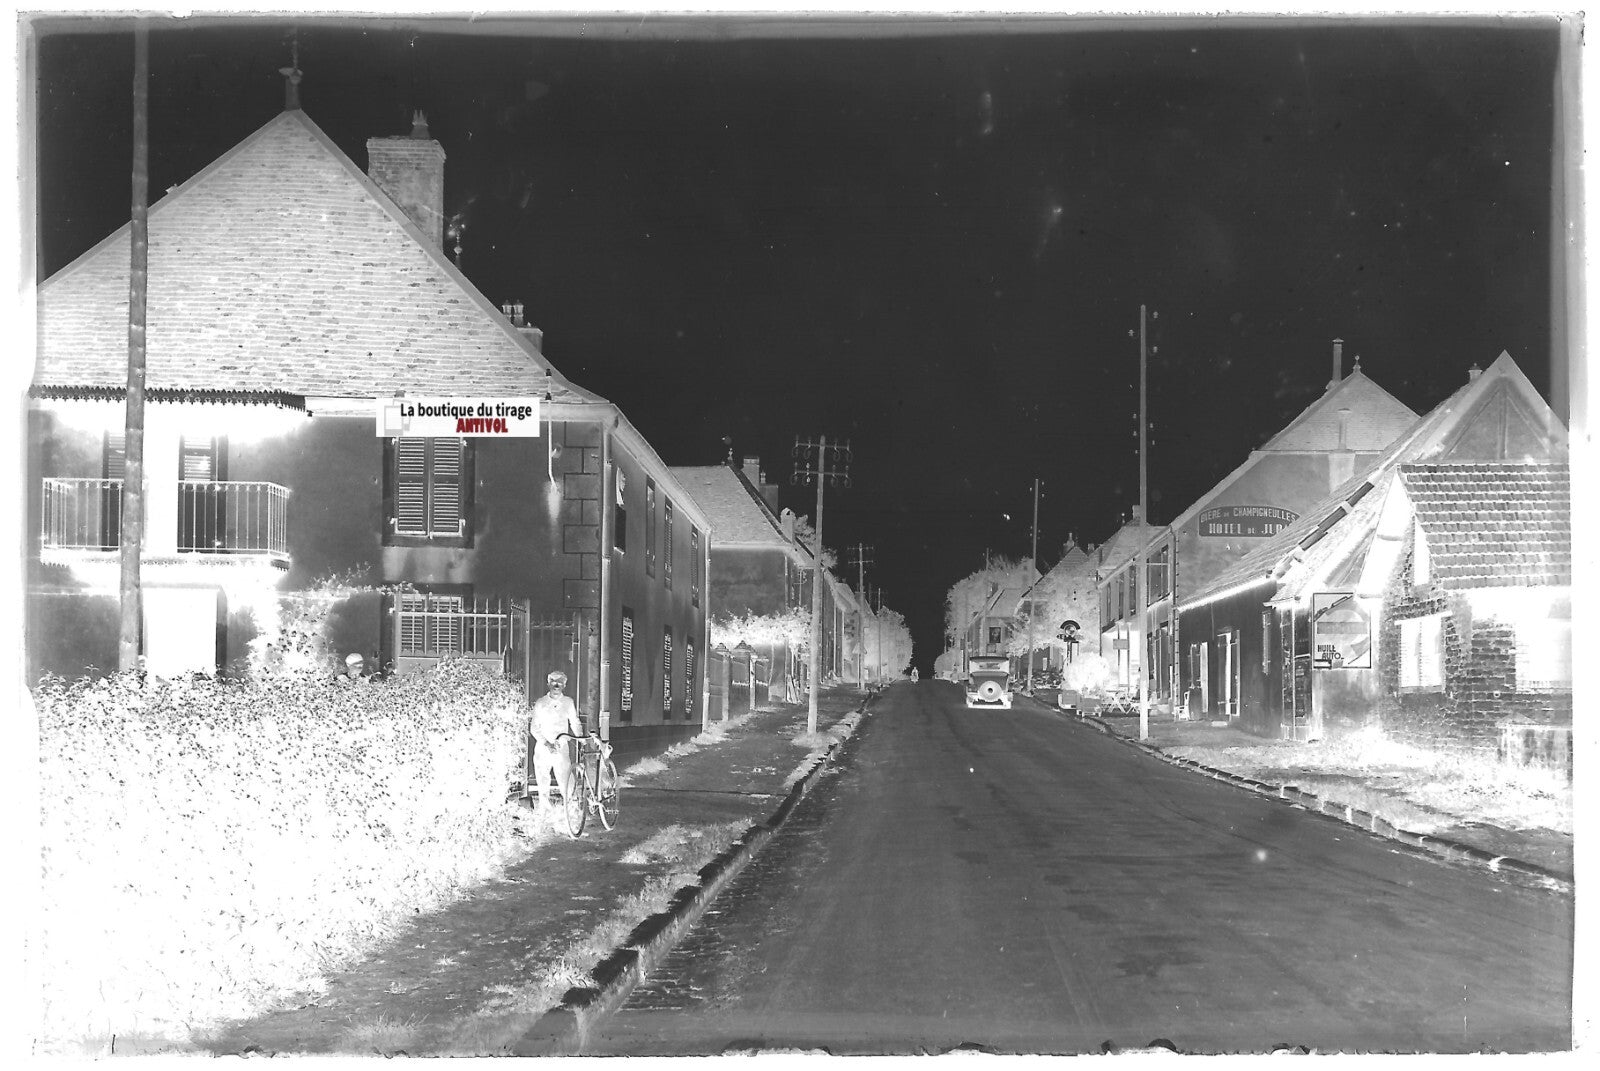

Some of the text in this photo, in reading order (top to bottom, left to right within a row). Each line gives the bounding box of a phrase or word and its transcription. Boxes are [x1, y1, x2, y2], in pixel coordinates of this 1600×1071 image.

[1233, 507, 1296, 522] CHAMPIGNEULLES
[1208, 523, 1242, 534] HOTEL
[1317, 644, 1336, 653] HUILE
